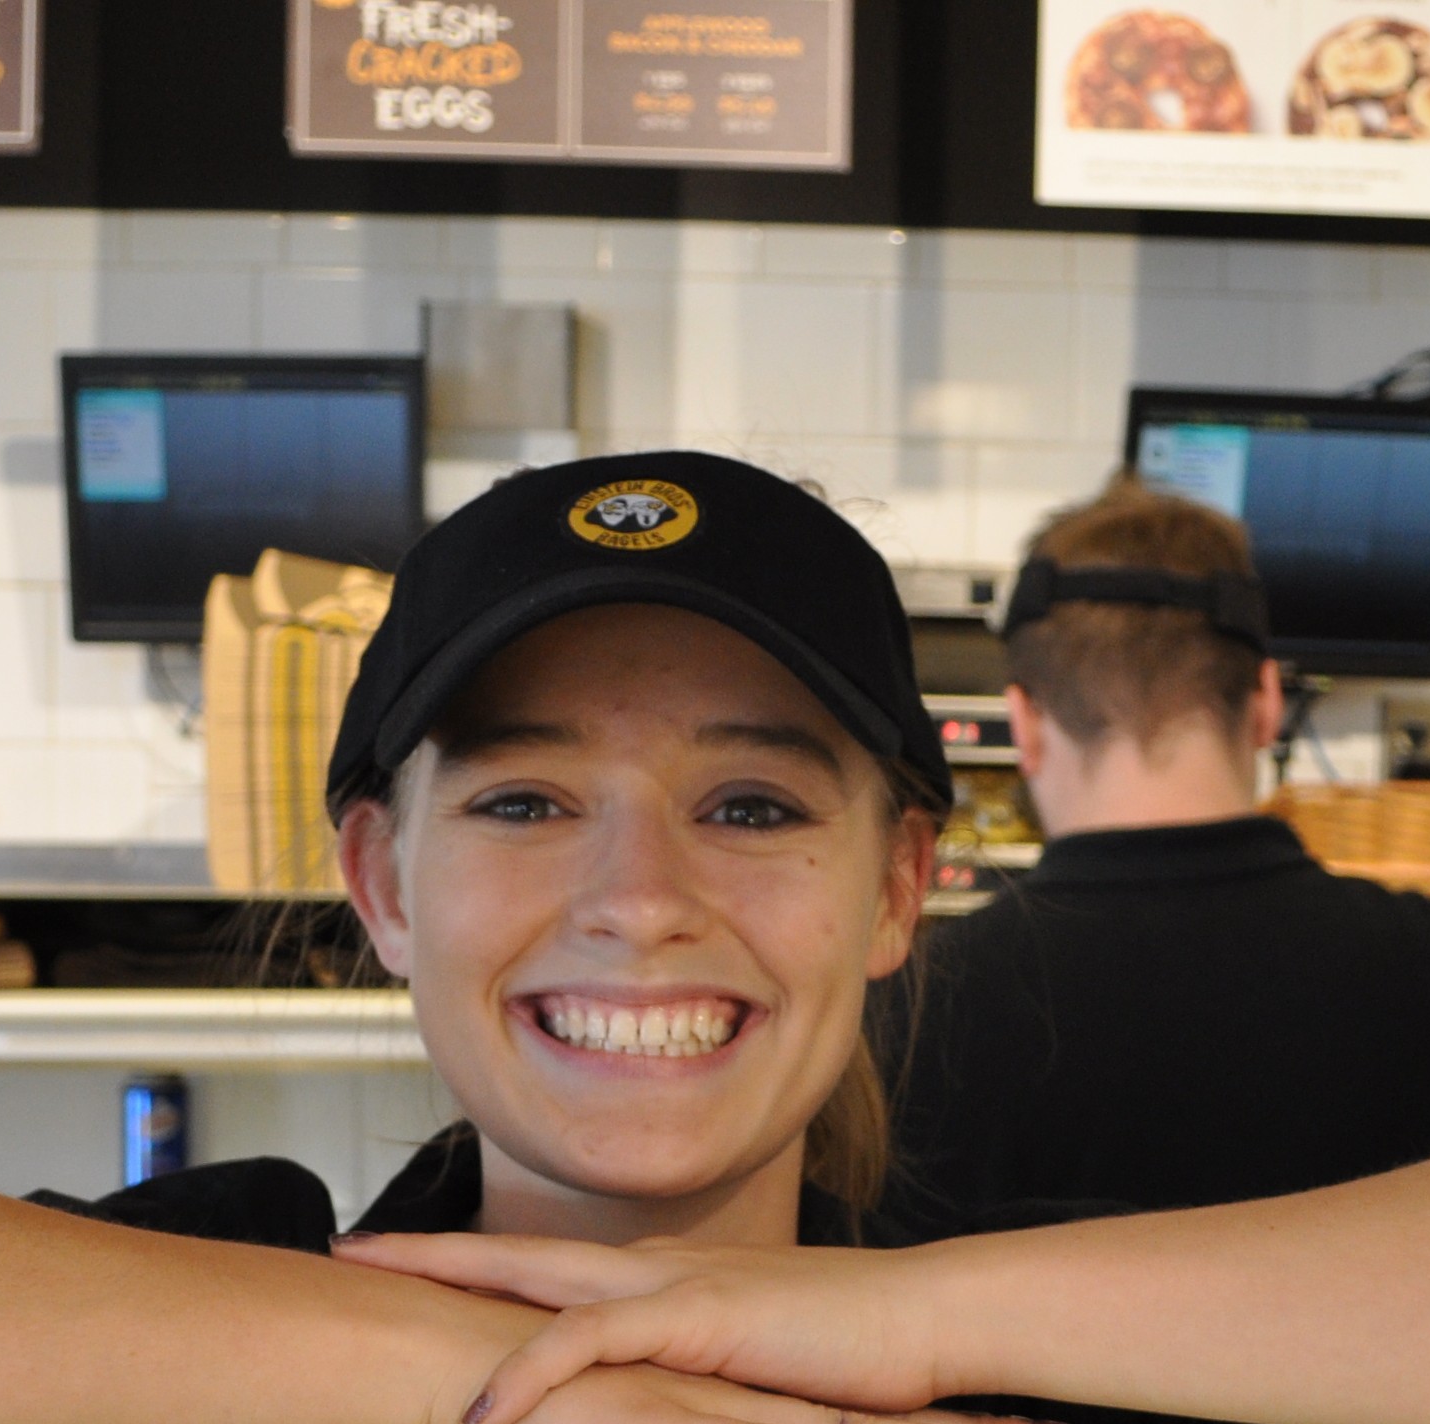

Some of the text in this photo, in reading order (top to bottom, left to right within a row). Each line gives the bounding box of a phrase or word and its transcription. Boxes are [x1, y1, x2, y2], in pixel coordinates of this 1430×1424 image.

[360, 0, 514, 47] FRESH-
[346, 40, 523, 87] CRACKED
[373, 86, 495, 132] EGGS
[597, 532, 666, 546] BAGELS
